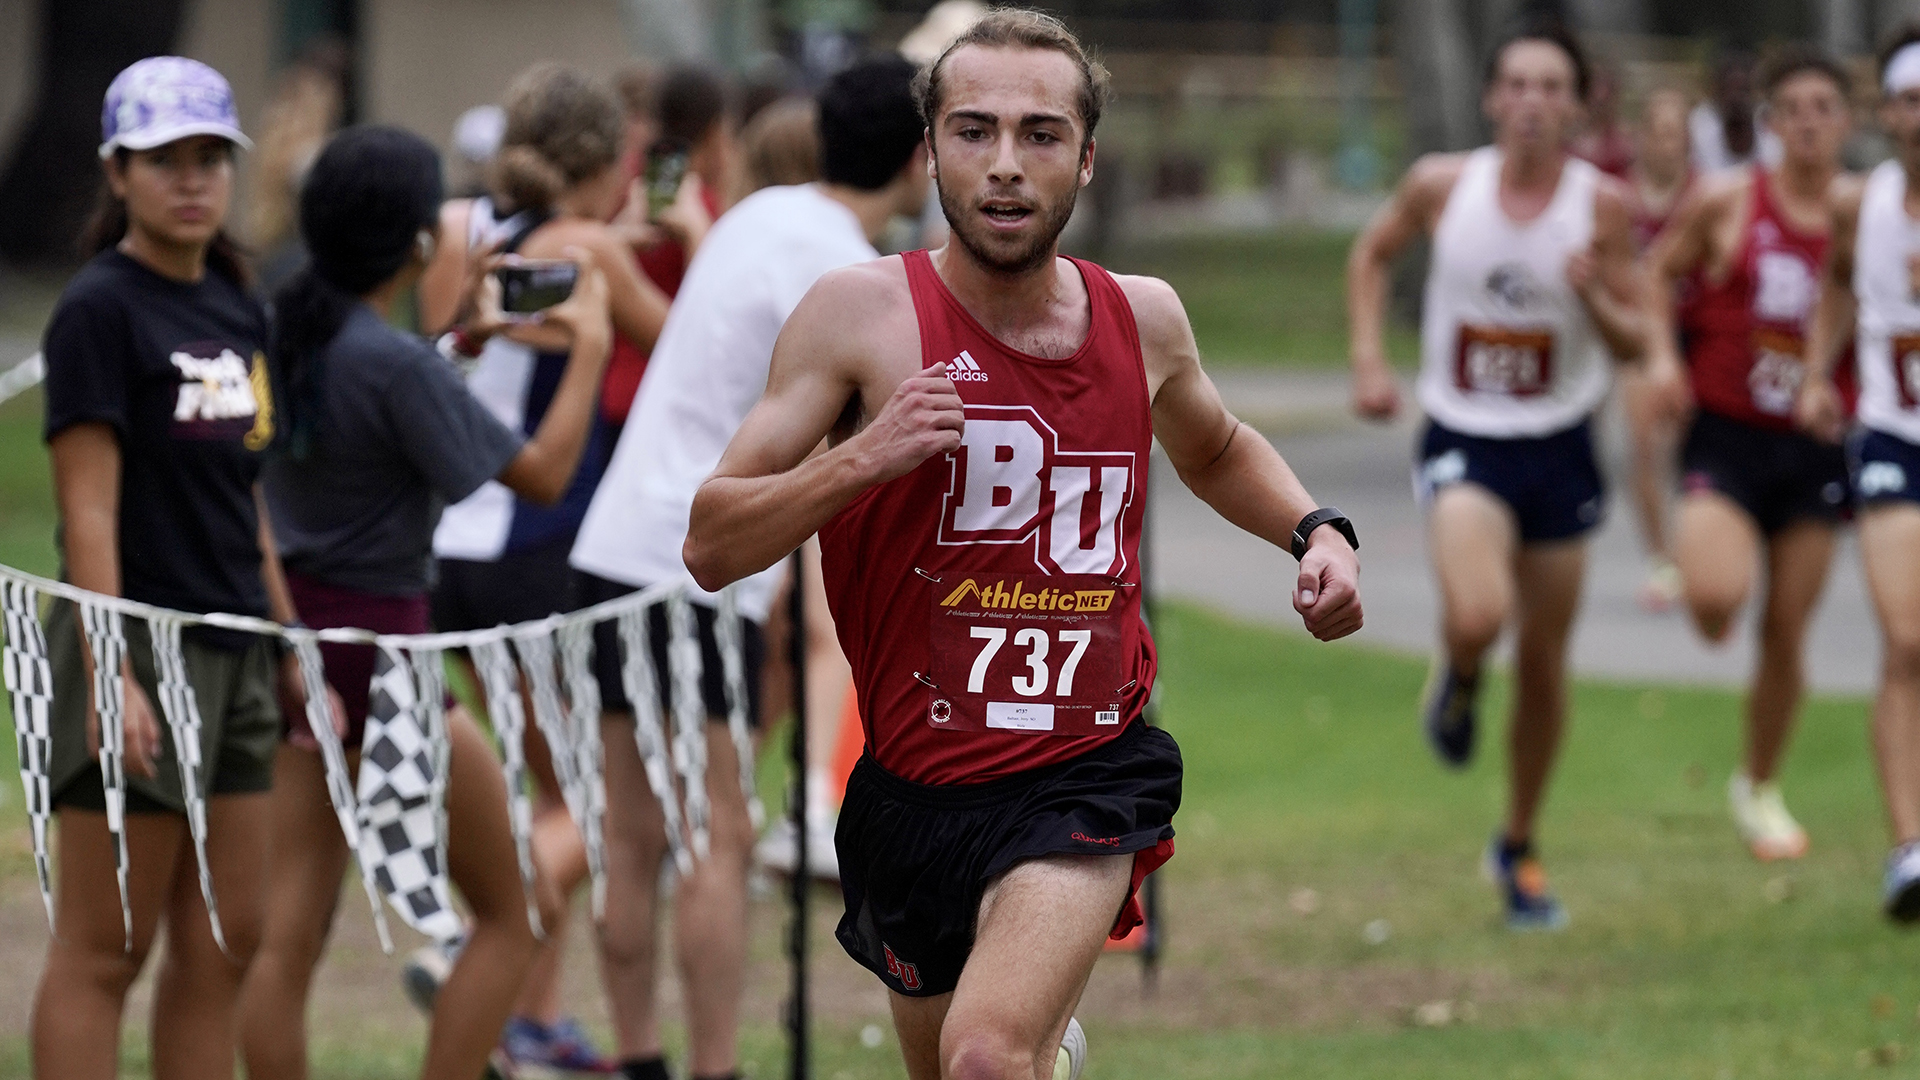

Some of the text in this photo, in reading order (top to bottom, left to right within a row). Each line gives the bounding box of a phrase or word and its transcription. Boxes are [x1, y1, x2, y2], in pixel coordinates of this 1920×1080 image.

[941, 407, 1134, 576] BU
[1079, 595, 1110, 609] NET
[967, 626, 1091, 697] 737
[1109, 703, 1120, 711] 737
[882, 941, 923, 990] BU
